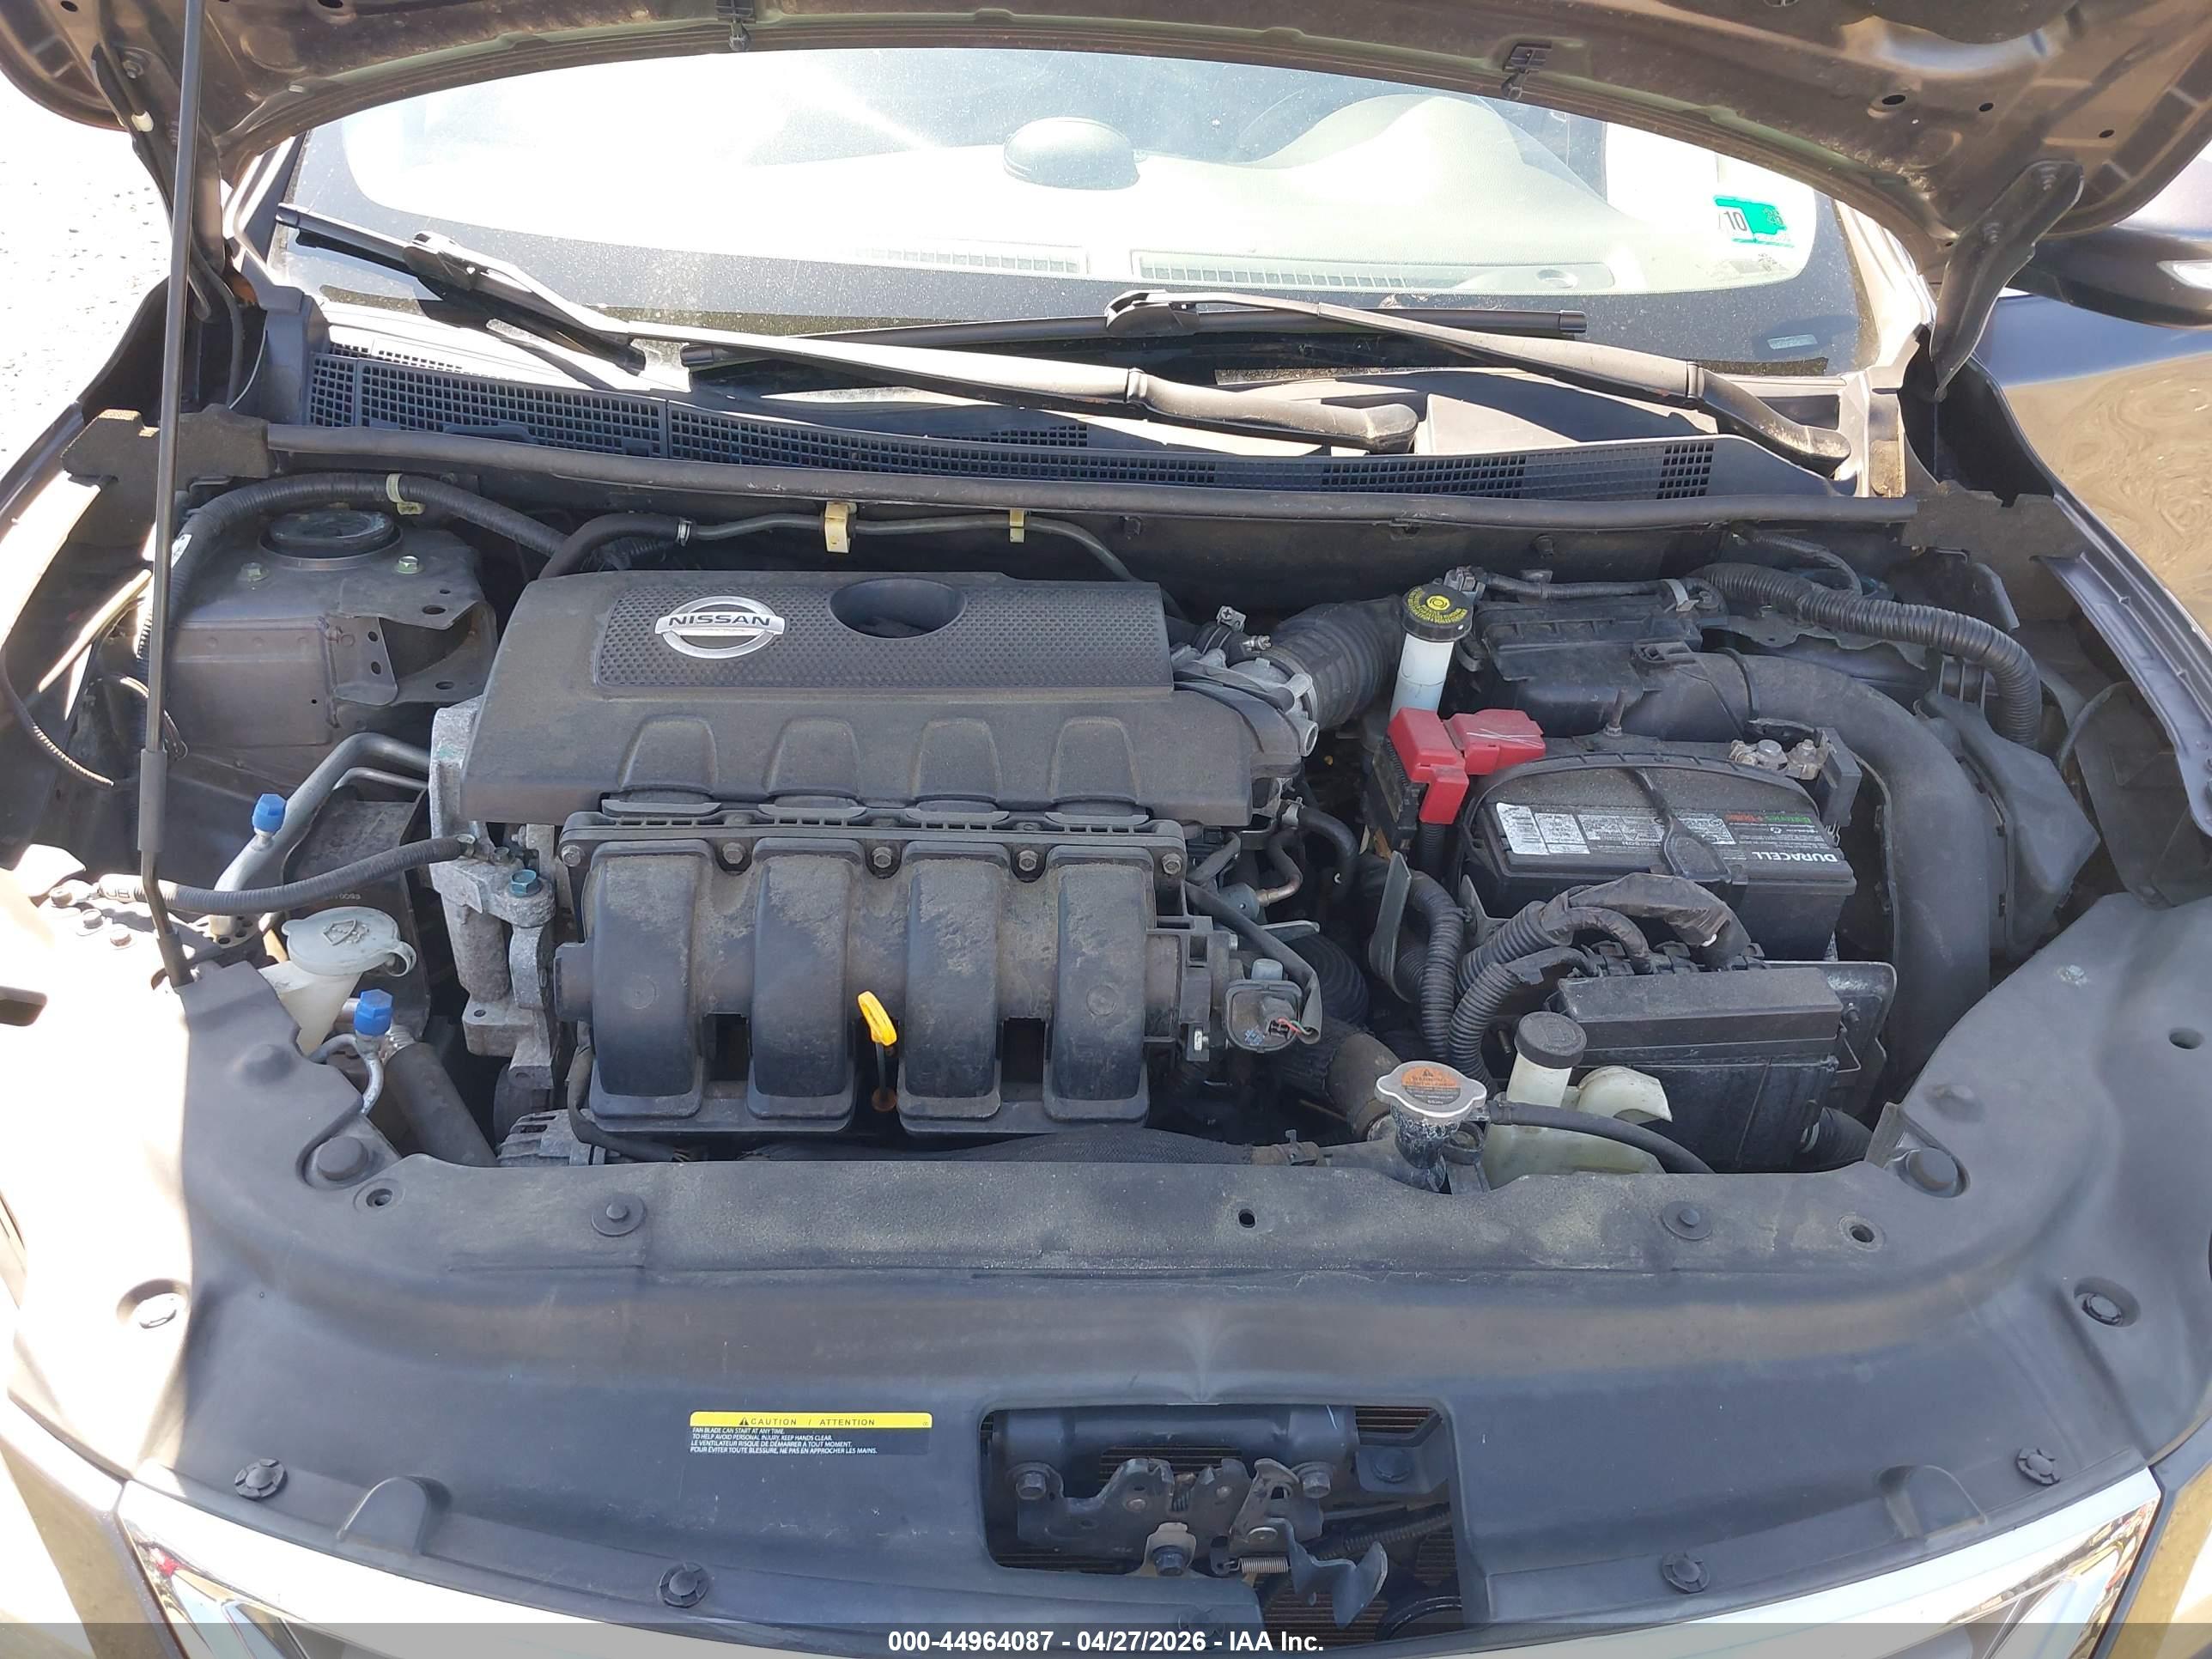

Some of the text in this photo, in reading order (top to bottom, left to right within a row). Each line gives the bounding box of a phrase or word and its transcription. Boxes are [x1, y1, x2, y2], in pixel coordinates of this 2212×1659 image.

[1723, 210, 1747, 231] 10
[668, 614, 771, 626] NISSAN
[1751, 851, 1838, 862] DURACELL
